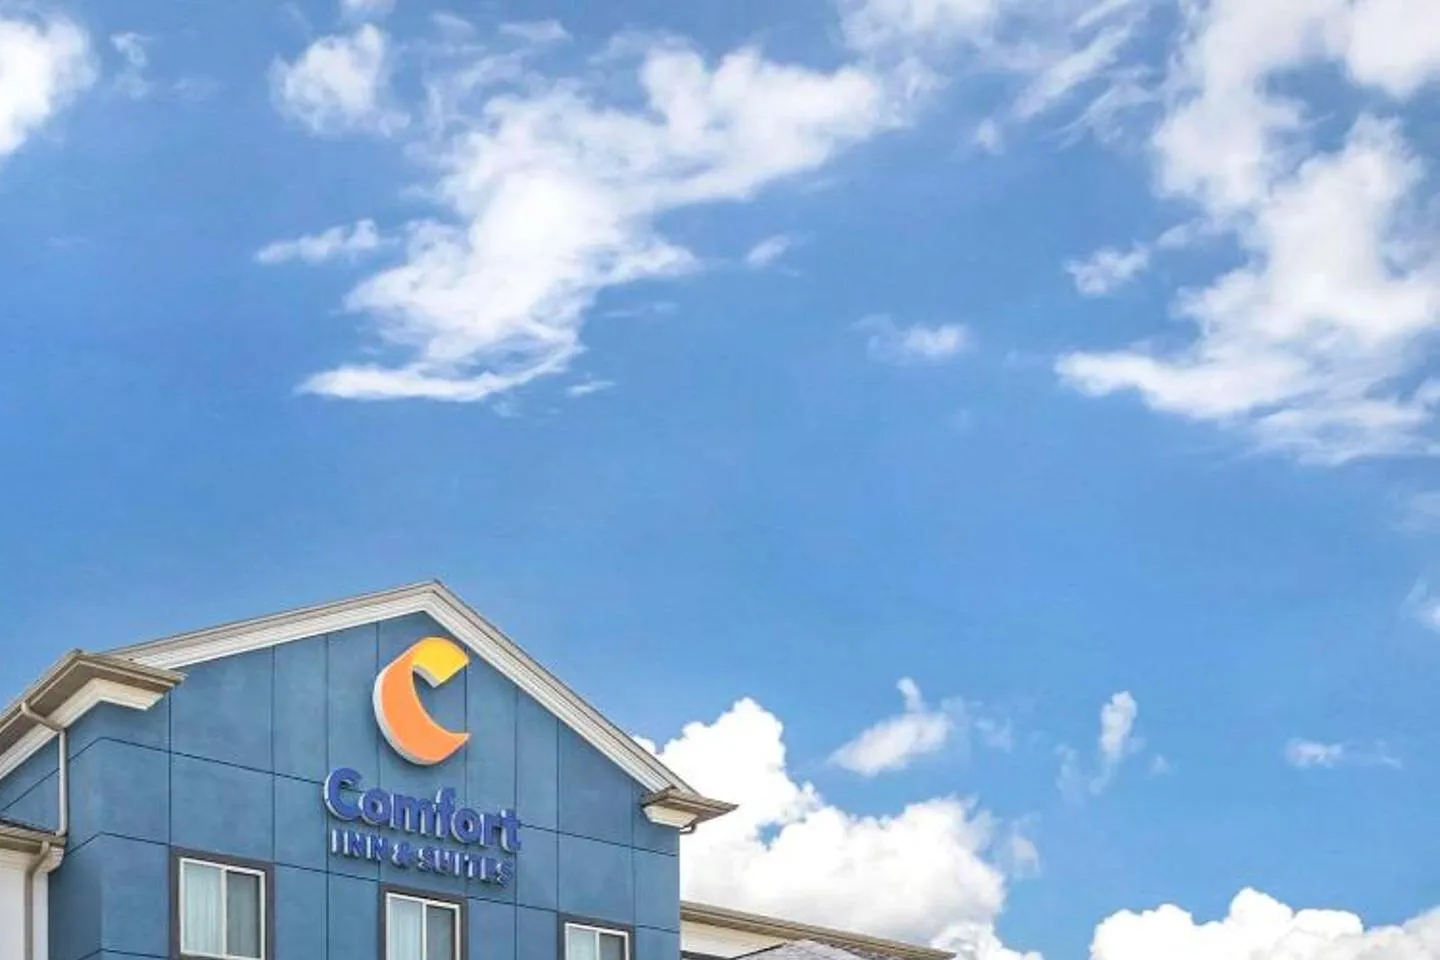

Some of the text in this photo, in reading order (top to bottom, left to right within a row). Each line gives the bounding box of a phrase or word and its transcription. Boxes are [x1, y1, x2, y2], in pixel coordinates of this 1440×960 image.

[324, 767, 521, 853] Comfort
[331, 829, 513, 887] INN & SUITES
